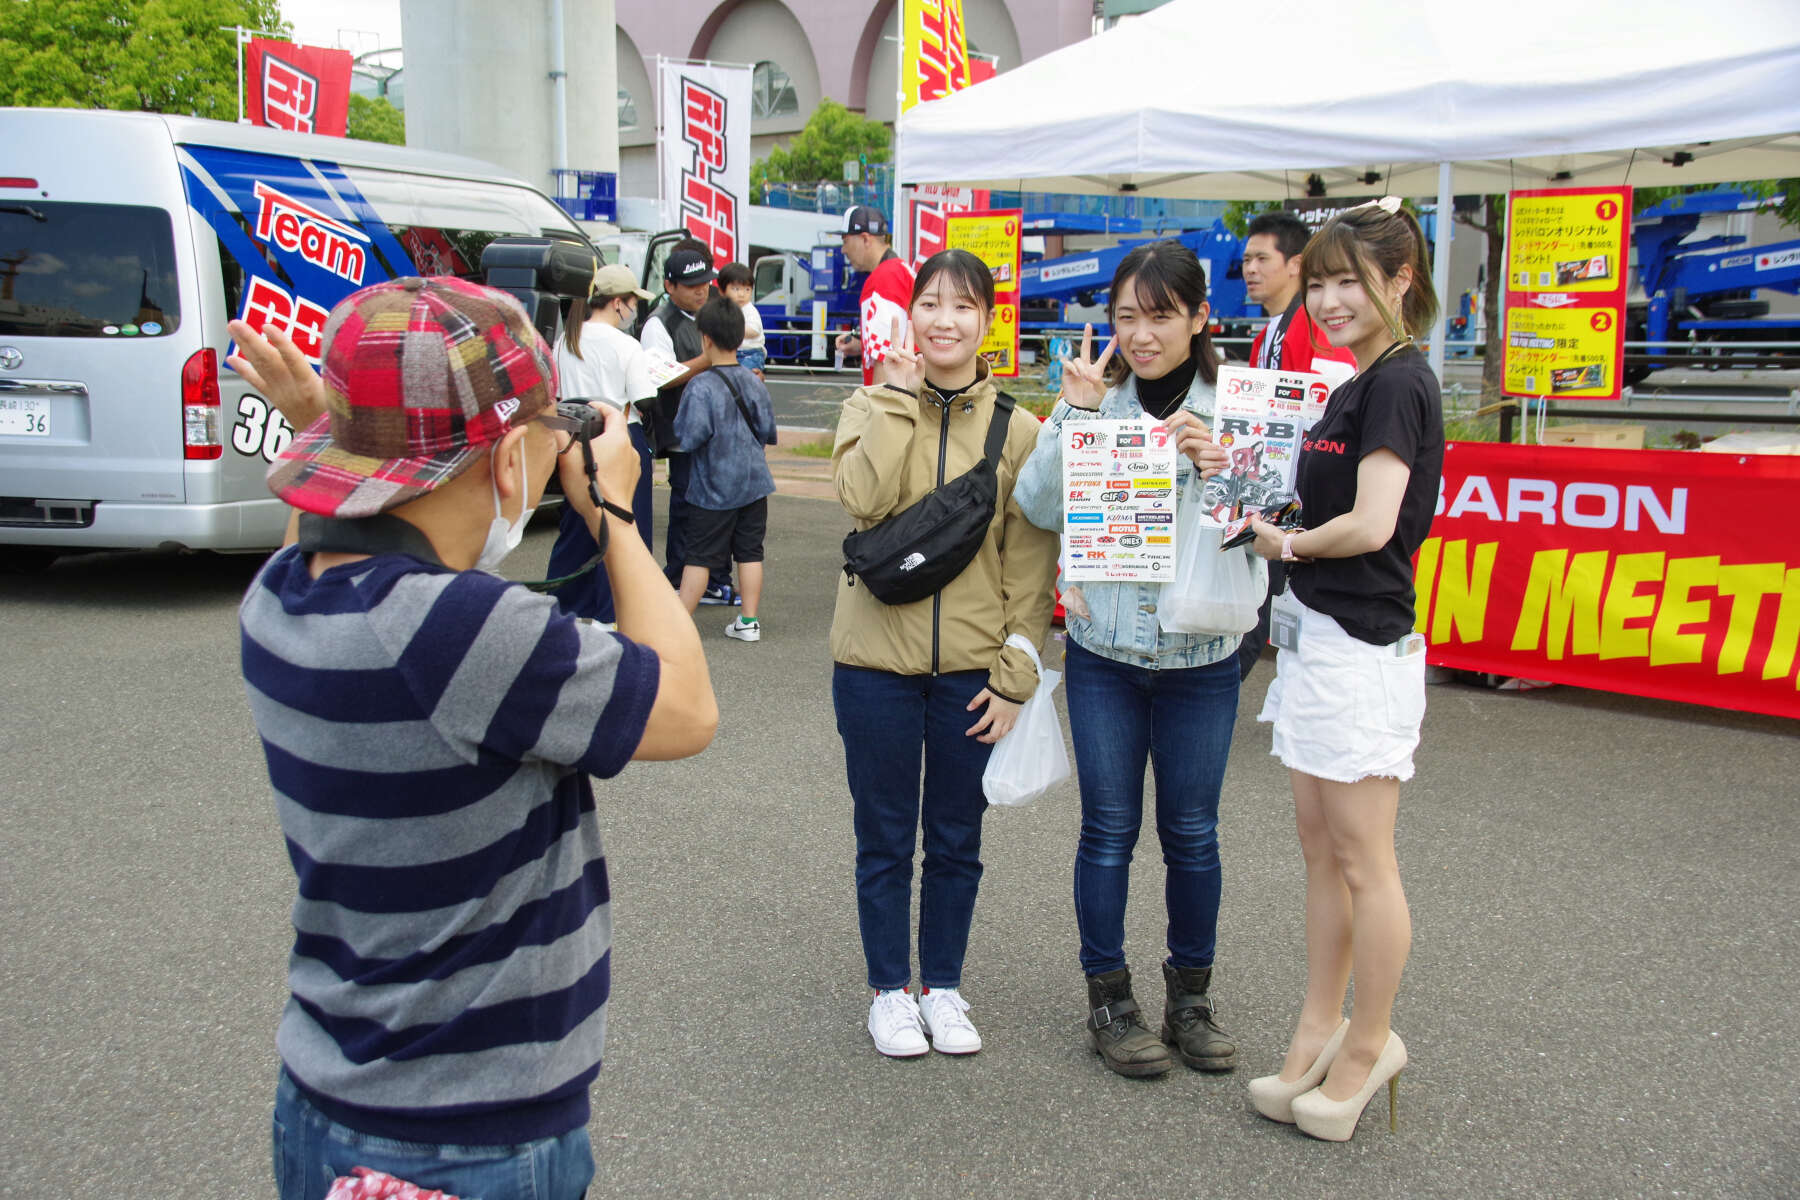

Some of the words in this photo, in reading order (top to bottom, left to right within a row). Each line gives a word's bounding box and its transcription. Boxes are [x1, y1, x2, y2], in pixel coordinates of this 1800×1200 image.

[254, 181, 371, 287] Team
[1516, 225, 1608, 237] レッドバロンオリジナル
[26, 413, 46, 432] 36
[233, 393, 295, 464] 36
[1069, 491, 1084, 499] EK
